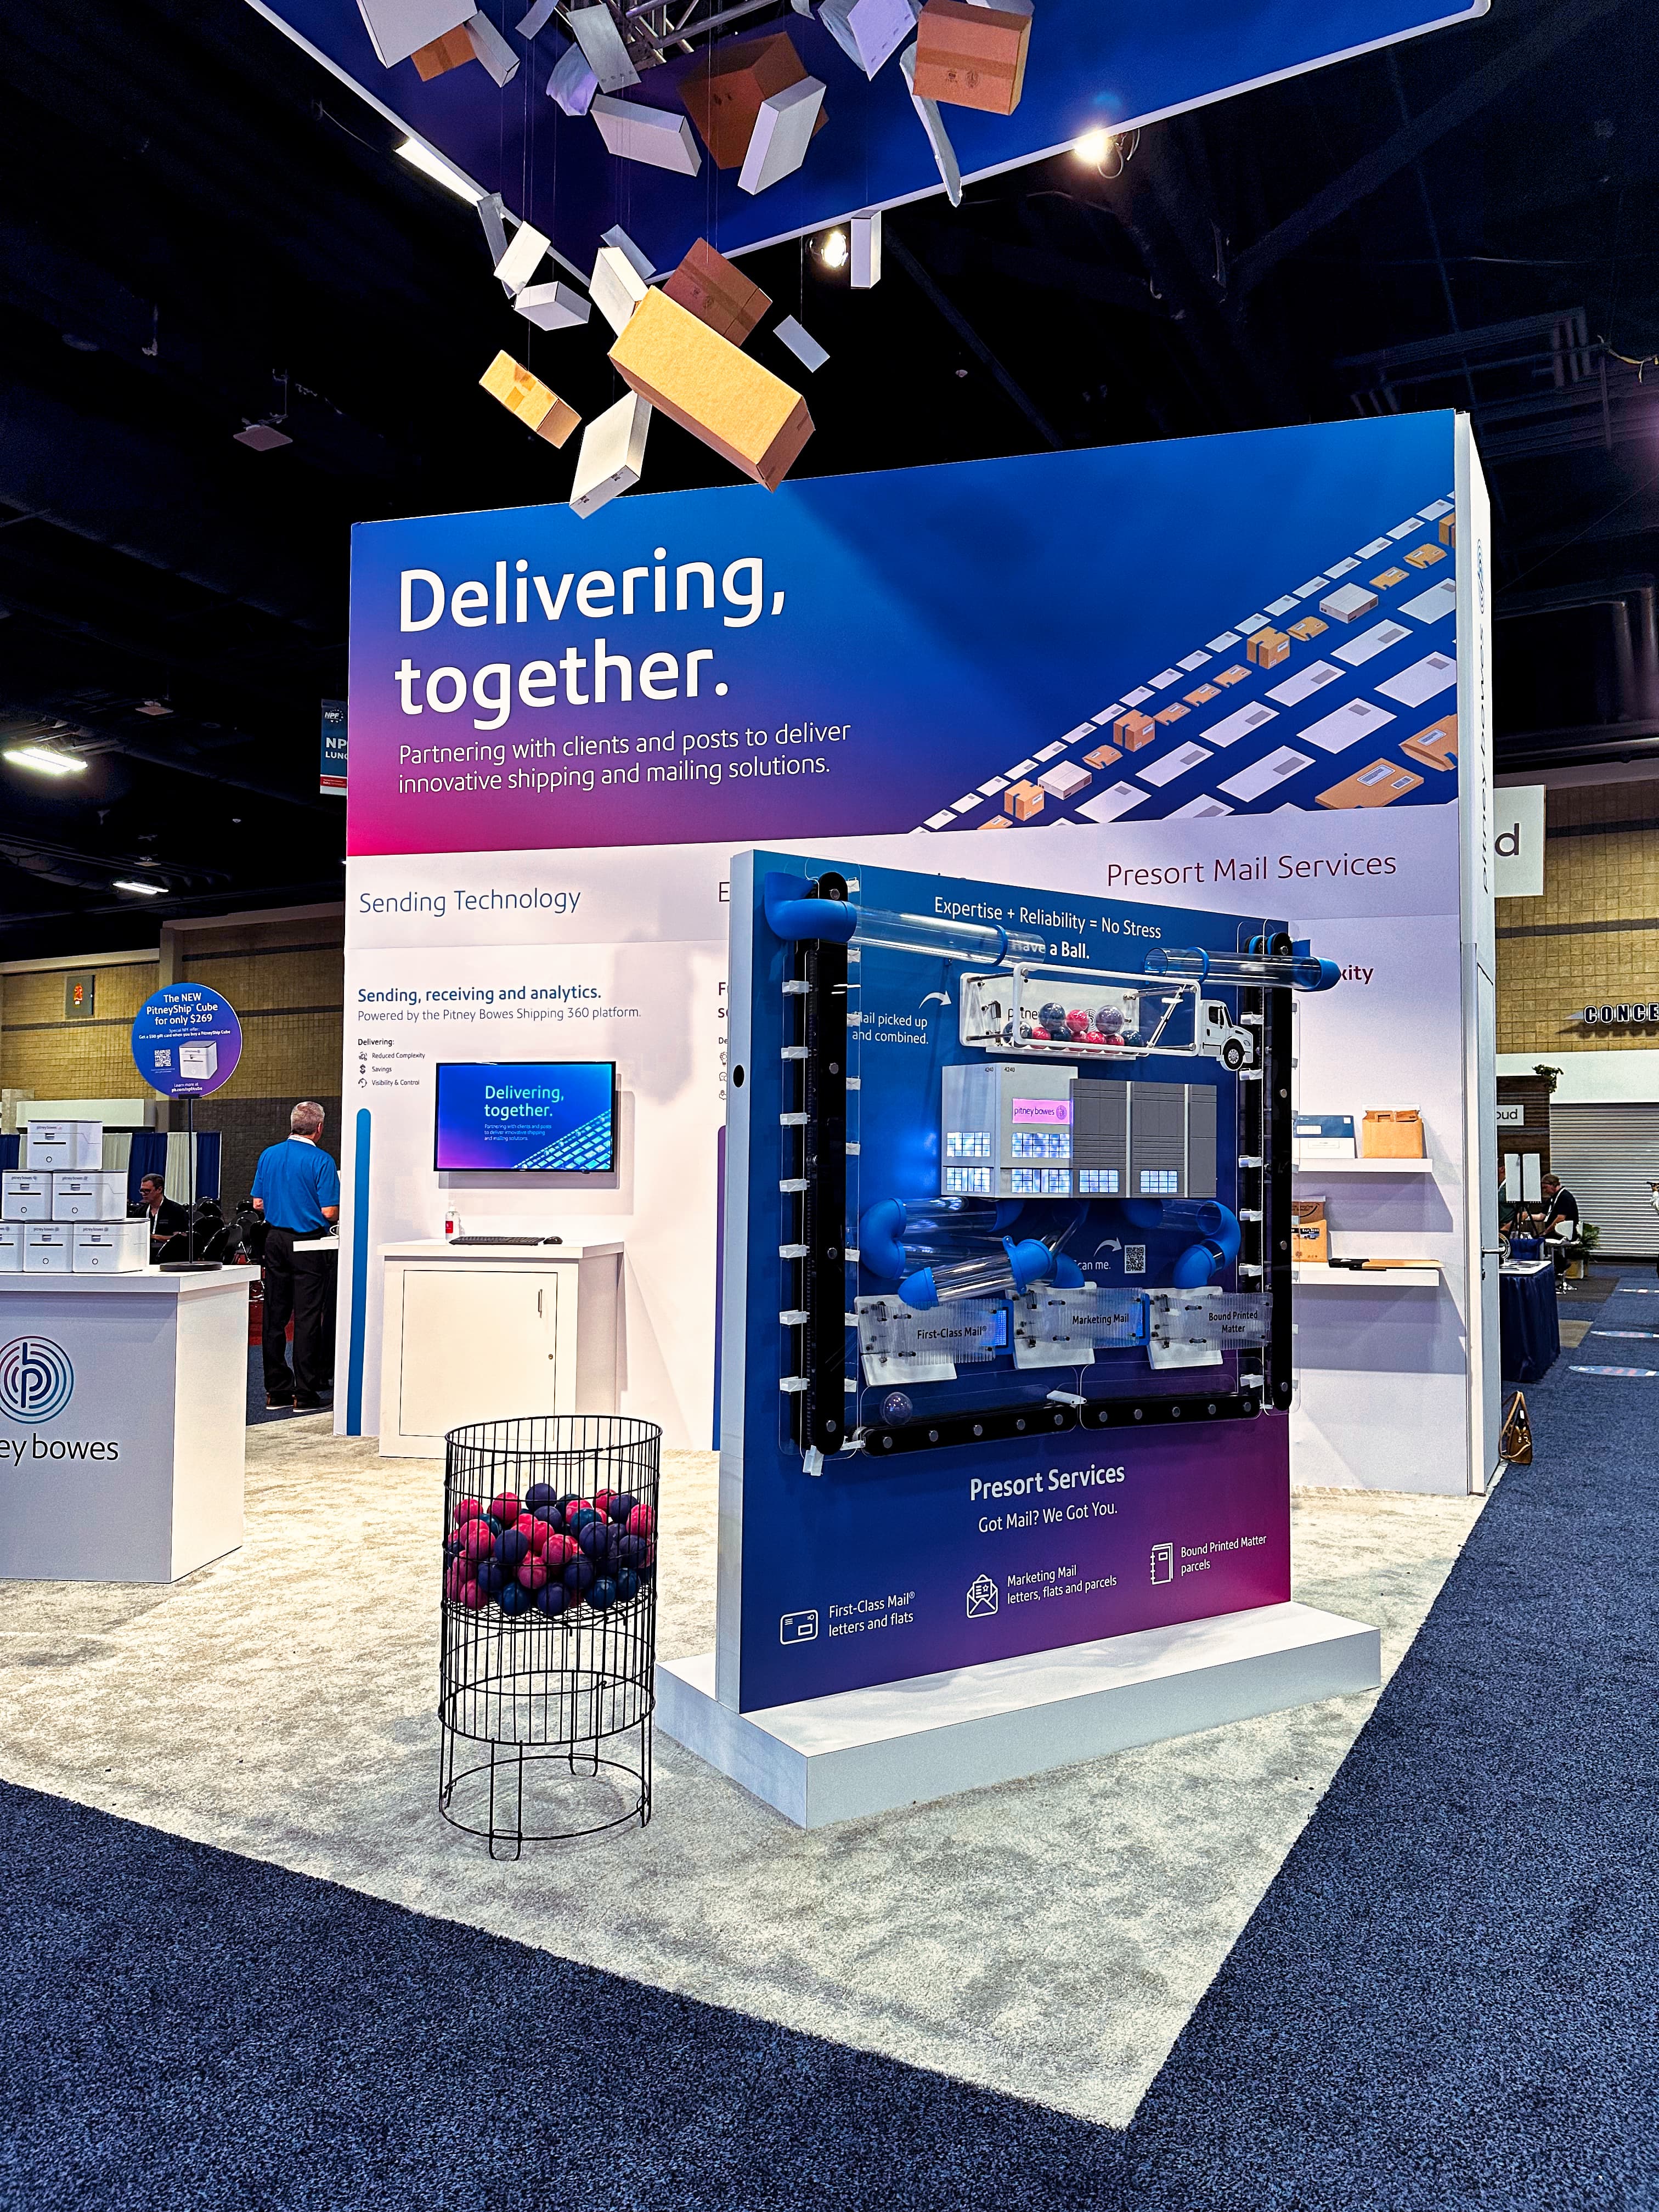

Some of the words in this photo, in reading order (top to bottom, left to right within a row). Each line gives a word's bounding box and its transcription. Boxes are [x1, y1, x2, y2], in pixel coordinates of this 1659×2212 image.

[400, 547, 786, 633] Delivering,
[394, 637, 729, 731] together.
[399, 741, 506, 766] Partnering
[512, 737, 556, 760] with
[563, 735, 629, 757] clients
[635, 731, 675, 753] and
[682, 729, 740, 756] posts
[746, 729, 768, 747] to
[775, 721, 851, 746] deliver
[399, 773, 502, 794] innovative
[507, 768, 595, 792] shipping
[602, 764, 639, 786] and
[647, 760, 722, 786] mailing
[729, 755, 831, 778] solutions.
[1108, 862, 1204, 886] Presort
[1214, 856, 1267, 882] Mail
[1278, 853, 1397, 879] Services
[359, 891, 446, 917] Sending
[454, 888, 582, 913] Technology
[935, 896, 1003, 920] Expertise
[1020, 907, 1086, 934] Reliability
[1102, 917, 1120, 934] No
[1123, 919, 1161, 938] Stress
[1049, 944, 1058, 956] a
[1062, 941, 1090, 959] Ball.
[163, 994, 179, 1003] The
[182, 992, 201, 1002] NEW
[358, 988, 421, 1005] Sending,
[426, 987, 494, 1004] receiving
[499, 986, 526, 1000] and
[531, 985, 601, 1003] analytics.
[196, 1003, 218, 1012] Cube
[358, 1010, 403, 1021] Powered
[407, 1010, 419, 1023] by
[422, 1010, 439, 1020] the
[443, 1009, 476, 1022] Pitney
[479, 1009, 514, 1019] Bowes
[517, 1008, 563, 1021] Shipping
[567, 1007, 589, 1018] 360
[592, 1007, 641, 1020] platform.
[155, 1017, 168, 1025] for
[170, 1016, 188, 1026] only
[190, 1013, 212, 1024] $269
[860, 1012, 875, 1023] ail
[878, 1013, 912, 1027] picked
[915, 1018, 928, 1030] up
[358, 1039, 394, 1047] Delivering:
[852, 1029, 872, 1040] and
[875, 1031, 929, 1044] combined.
[486, 1085, 564, 1103] Delivering,
[484, 1103, 552, 1120] together.
[1014, 1108, 1035, 1116] pitney
[1035, 1107, 1054, 1115] bowes
[1074, 1260, 1092, 1270] can
[1072, 1313, 1112, 1327] Marketing
[1114, 1312, 1129, 1323] Mail
[1209, 1312, 1230, 1322] Bound
[1231, 1310, 1258, 1321] Printed
[917, 1328, 962, 1339] First-Class
[1221, 1323, 1245, 1333] Matter
[32, 1432, 119, 1460] bowes
[970, 1472, 1043, 1501] Presort
[1048, 1464, 1125, 1491] Services
[978, 1515, 1003, 1533] Got
[1006, 1508, 1039, 1528] Mail?
[1042, 1508, 1063, 1523] We
[1066, 1504, 1089, 1521] Got
[1092, 1501, 1118, 1517] You.
[1181, 1543, 1207, 1559] Bound
[1210, 1538, 1238, 1555] Printed
[1240, 1535, 1267, 1550] Matter
[1007, 1570, 1055, 1588] Marketing
[1057, 1565, 1077, 1580] Mail
[1181, 1558, 1211, 1577] parcels
[1007, 1587, 1041, 1605] letters,
[1043, 1583, 1063, 1600] flats
[1065, 1581, 1082, 1596] and
[1085, 1573, 1117, 1594] parcels
[829, 1599, 885, 1618] First-Class
[829, 1620, 865, 1638] letters
[868, 1616, 888, 1632] and
[890, 1610, 914, 1627] flats
